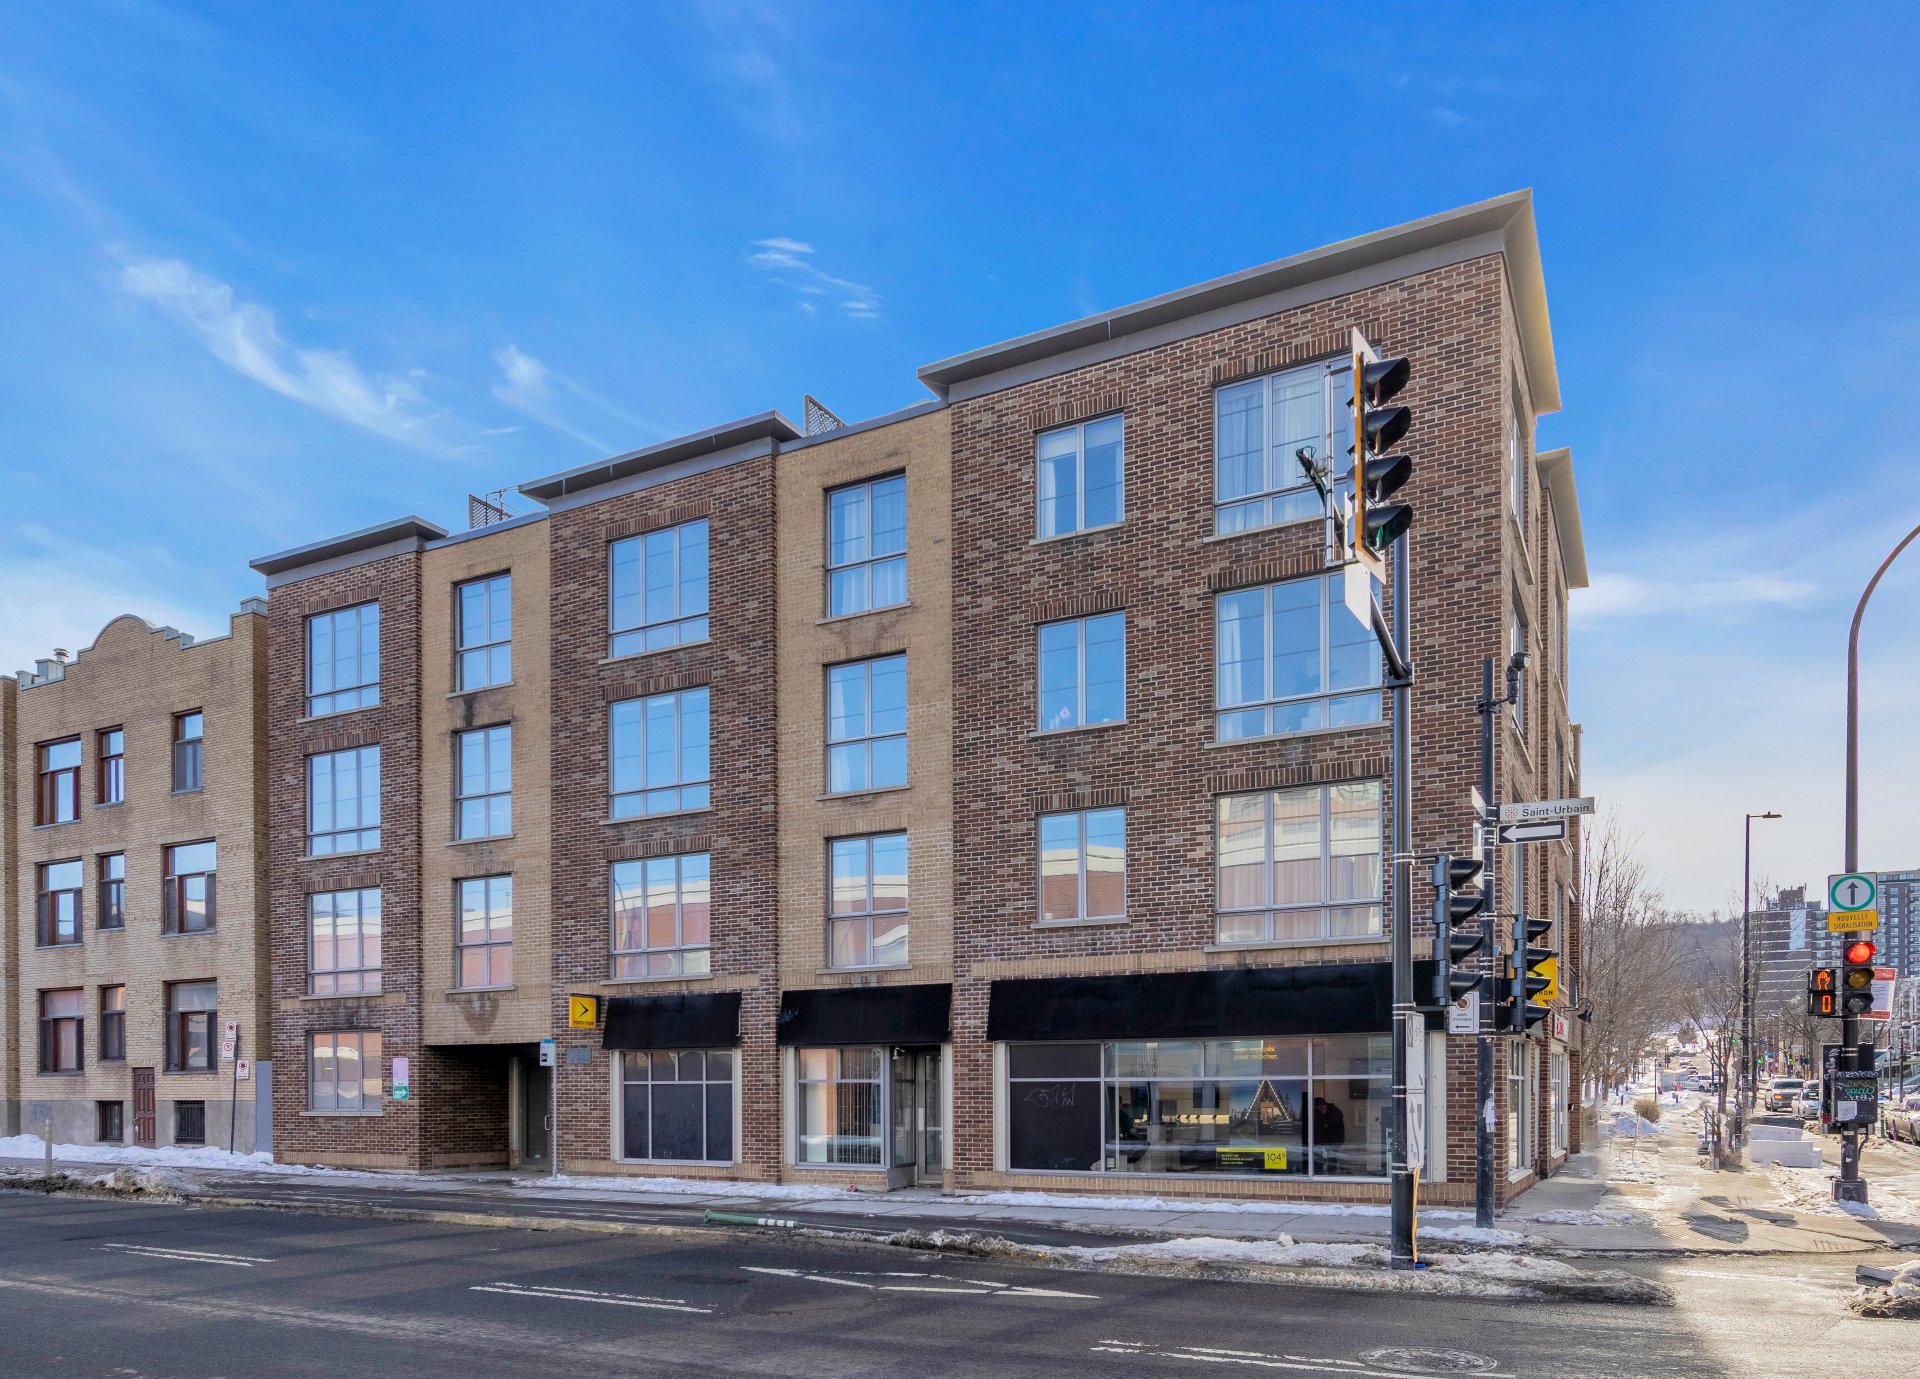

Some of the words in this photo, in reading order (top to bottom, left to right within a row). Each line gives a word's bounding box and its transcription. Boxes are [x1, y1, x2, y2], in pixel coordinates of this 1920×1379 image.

[1522, 804, 1590, 817] Saint-Urbain
[1836, 913, 1869, 921] NOUVELLE
[1833, 921, 1873, 929] SIGNALISATION
[1822, 995, 1831, 1013] 0
